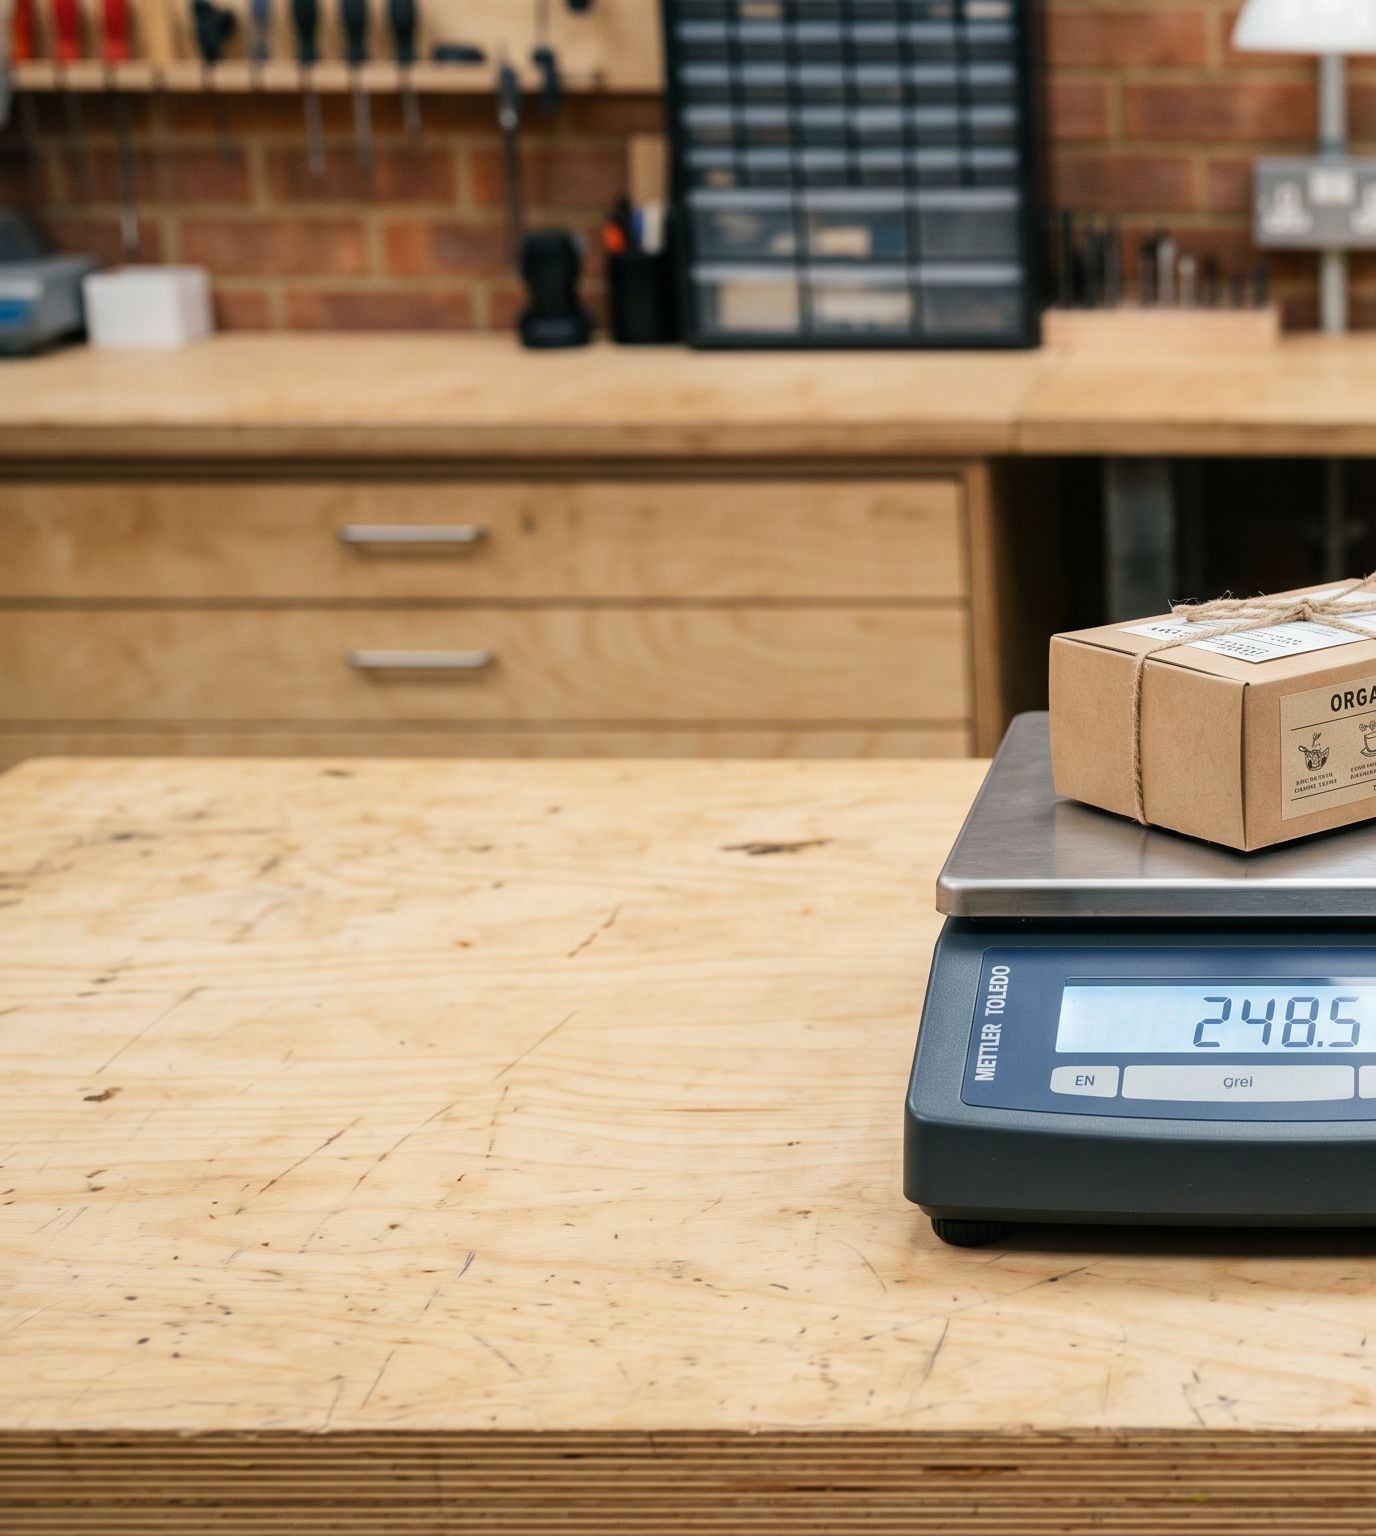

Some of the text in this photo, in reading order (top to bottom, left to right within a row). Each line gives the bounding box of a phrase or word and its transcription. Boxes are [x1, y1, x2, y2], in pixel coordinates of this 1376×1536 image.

[974, 965, 1011, 1081] METTLER TOLEDO
[1192, 996, 1361, 1048] 248.5
[1074, 1075, 1096, 1087] EN
